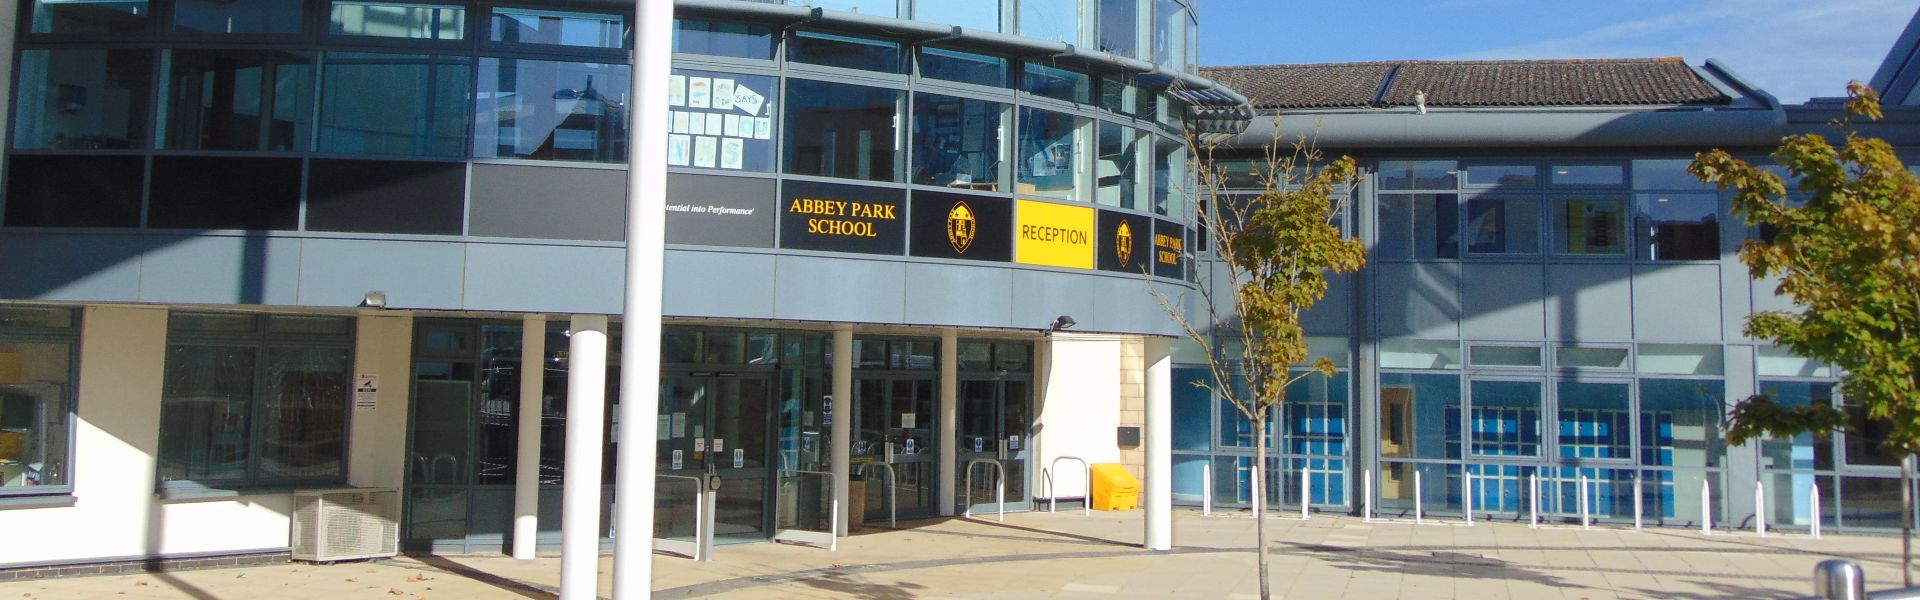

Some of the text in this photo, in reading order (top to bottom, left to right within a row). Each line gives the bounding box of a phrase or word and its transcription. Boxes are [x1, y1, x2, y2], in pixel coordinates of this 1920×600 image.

[734, 94, 759, 105] SAYS
[664, 203, 691, 213] tential
[691, 204, 707, 213] into
[789, 198, 897, 220] ABBEY PARK
[808, 218, 877, 237] SCHOOL
[1022, 224, 1087, 245] RECEPTION
